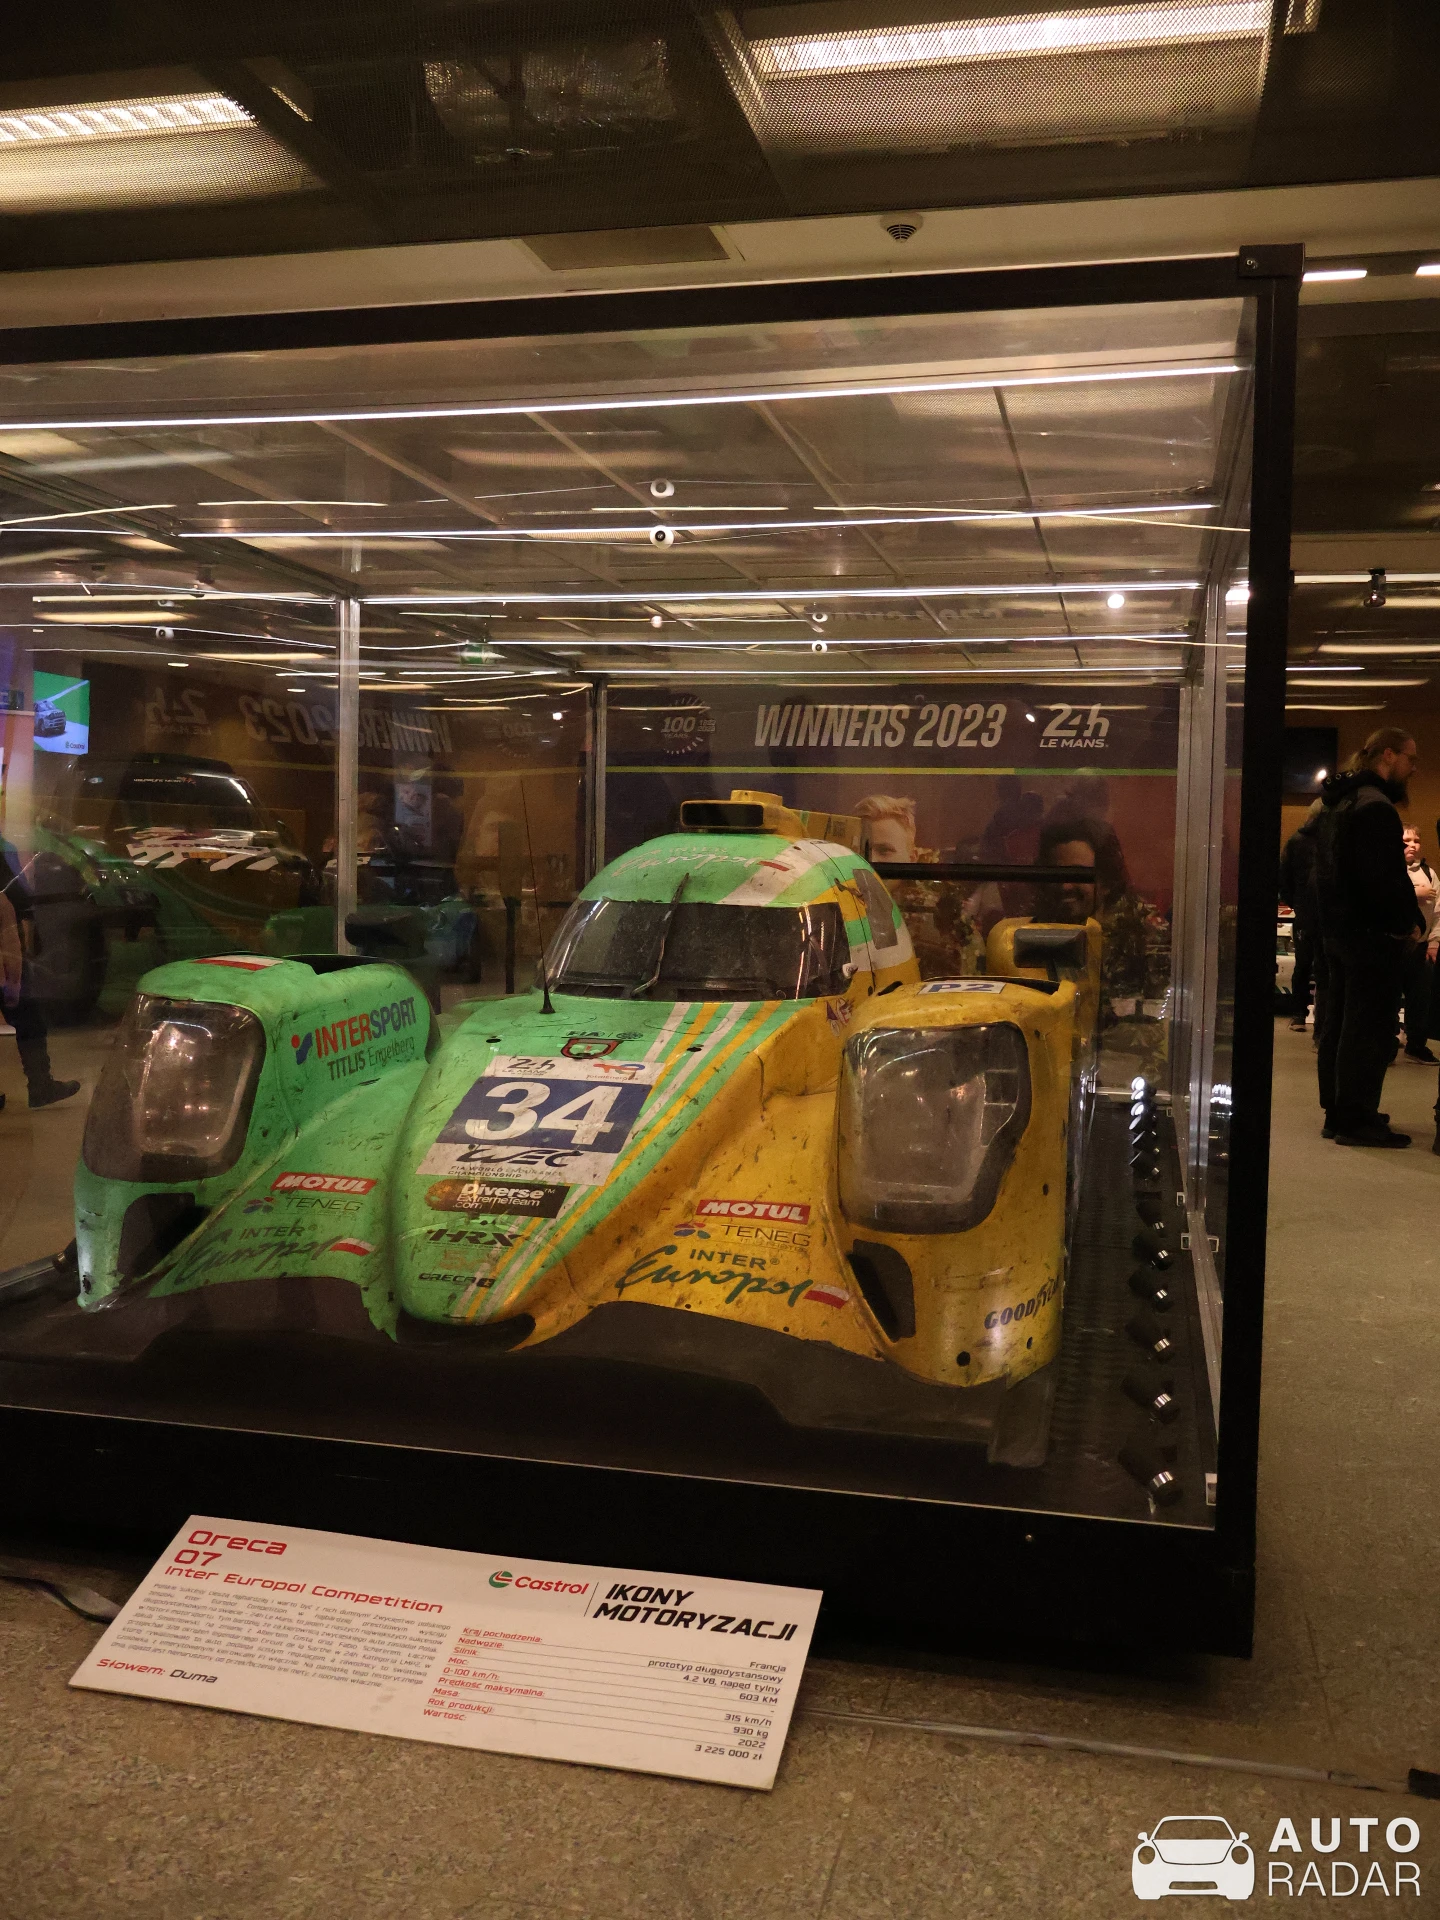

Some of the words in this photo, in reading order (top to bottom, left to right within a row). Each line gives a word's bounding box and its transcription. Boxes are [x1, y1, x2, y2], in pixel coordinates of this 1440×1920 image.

[661, 716, 696, 733] 100
[754, 703, 910, 747] WINNERS
[912, 703, 1007, 748] 2023
[1042, 702, 1110, 737] 24h
[1040, 738, 1059, 748] LE
[928, 983, 995, 993] P2
[315, 997, 416, 1059] INTERSPORT
[327, 1050, 366, 1081] TITLIS
[367, 1036, 415, 1068] Engelberg
[465, 1081, 622, 1145] 34
[456, 1147, 584, 1168] WEC
[276, 1175, 368, 1192] MOTUL
[448, 1171, 522, 1179] CHAMPIONSHIP
[285, 1196, 364, 1212] TENEG
[457, 1193, 540, 1207] ExtremeTeam
[701, 1201, 805, 1221] MOTUL
[429, 1229, 526, 1247] HRX
[721, 1225, 811, 1246] TENEG
[615, 1244, 813, 1308] Europol
[188, 1530, 287, 1555] Oreca
[174, 1549, 222, 1567] 07
[164, 1565, 219, 1581] Inter
[223, 1573, 307, 1593] Europol
[311, 1585, 444, 1614] Competition
[515, 1576, 590, 1595] Castrol
[605, 1583, 695, 1606] IKONY
[593, 1602, 798, 1641] MOTORYZACJI
[458, 1637, 504, 1649] Nadwozie:
[463, 1627, 481, 1637] Kraj
[483, 1630, 543, 1643] pochodzenia:
[362, 1654, 397, 1664] Kategoria
[448, 1657, 469, 1665] Moc:
[750, 1661, 786, 1673] Francja
[96, 1657, 166, 1676] Słowem:
[169, 1668, 219, 1684] Duma
[443, 1667, 470, 1676] 0-100
[472, 1671, 500, 1680] km/h:
[648, 1660, 693, 1671] prototyp
[695, 1665, 784, 1684] długodystansowy
[433, 1687, 460, 1697] Masa:
[484, 1684, 545, 1697] maksymalna:
[683, 1674, 699, 1683] 4.2
[720, 1680, 751, 1690] napęd
[754, 1684, 781, 1695] tylny
[427, 1698, 445, 1706] Rok
[448, 1701, 494, 1714] produkcji:
[739, 1692, 760, 1702] 603
[762, 1695, 778, 1704] KM
[724, 1713, 741, 1722] 315
[744, 1716, 772, 1727] km/h
[733, 1726, 754, 1736] 930
[756, 1729, 769, 1739] kg
[738, 1738, 766, 1749] 2022
[694, 1744, 702, 1752] 3
[704, 1746, 725, 1755] 225
[728, 1749, 749, 1759] 000
[752, 1752, 762, 1761] zł
